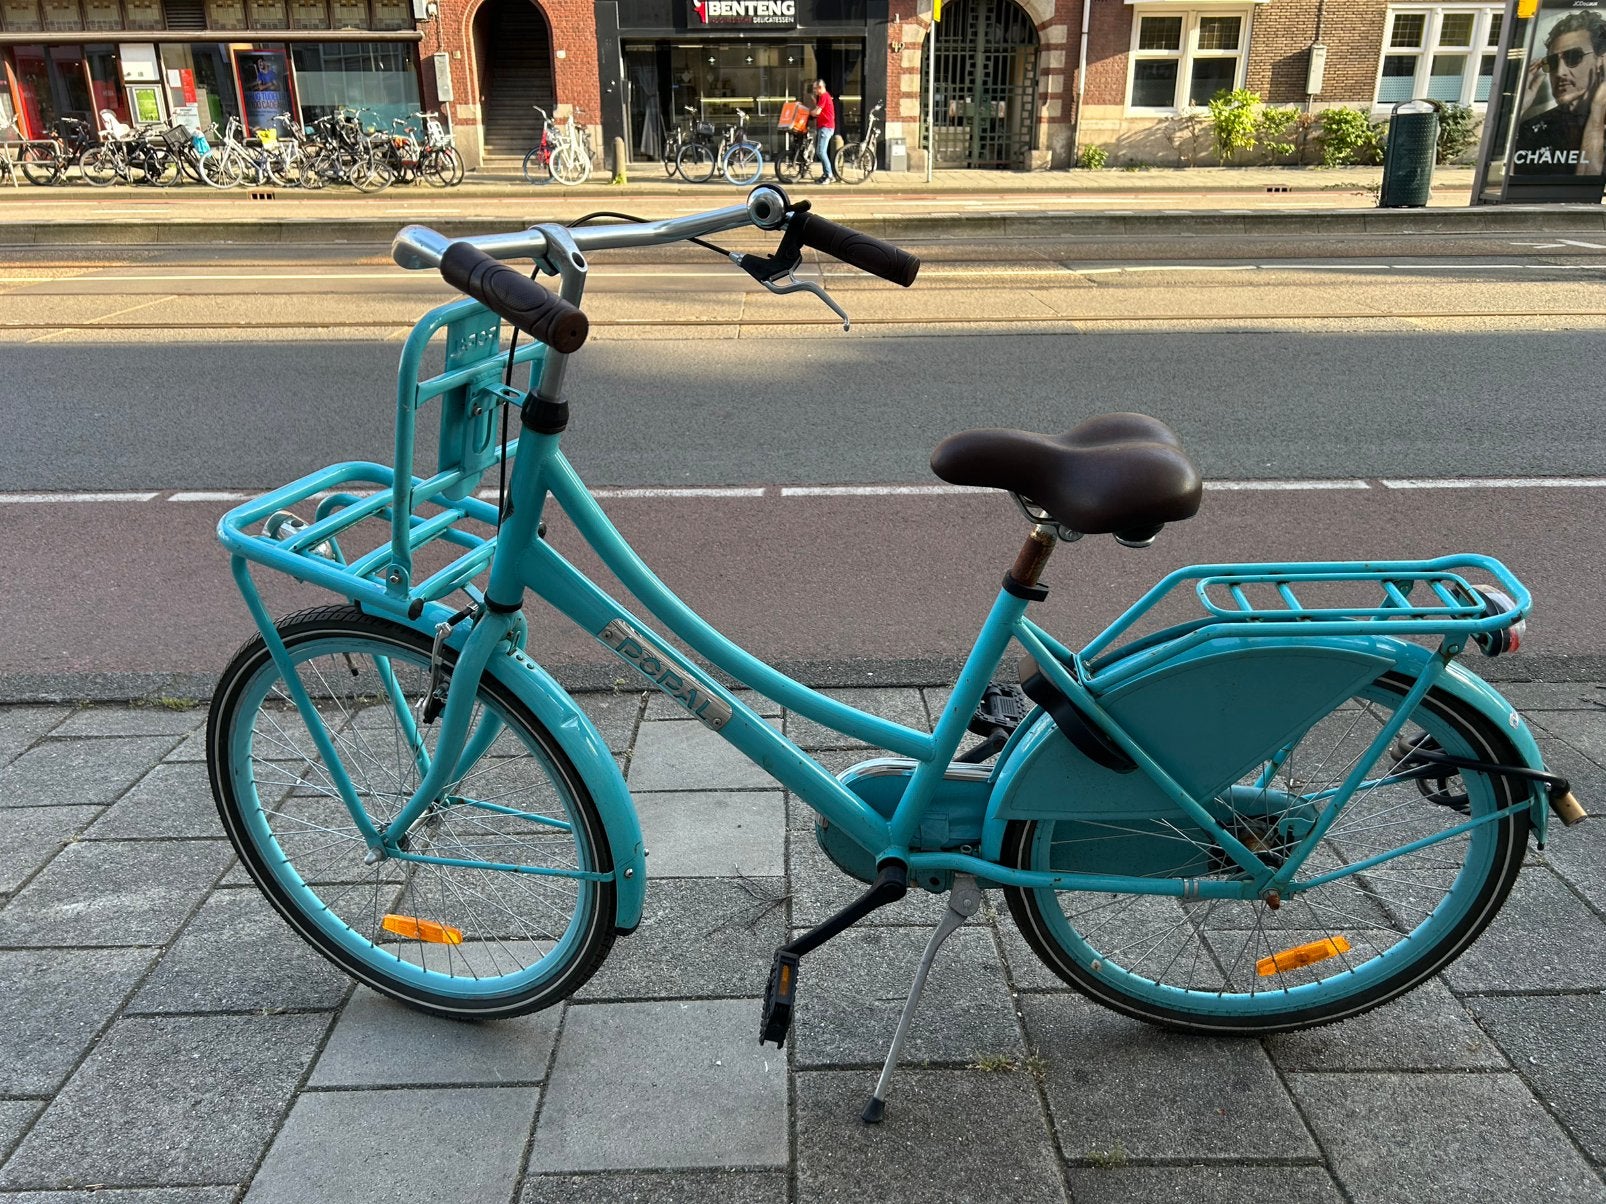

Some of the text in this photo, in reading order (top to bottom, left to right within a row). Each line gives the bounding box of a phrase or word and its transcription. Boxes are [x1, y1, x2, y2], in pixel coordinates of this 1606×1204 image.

[709, 1, 795, 16] BENTENG
[753, 16, 794, 24] DELICATESSEN
[1514, 150, 1590, 164] CHANEL
